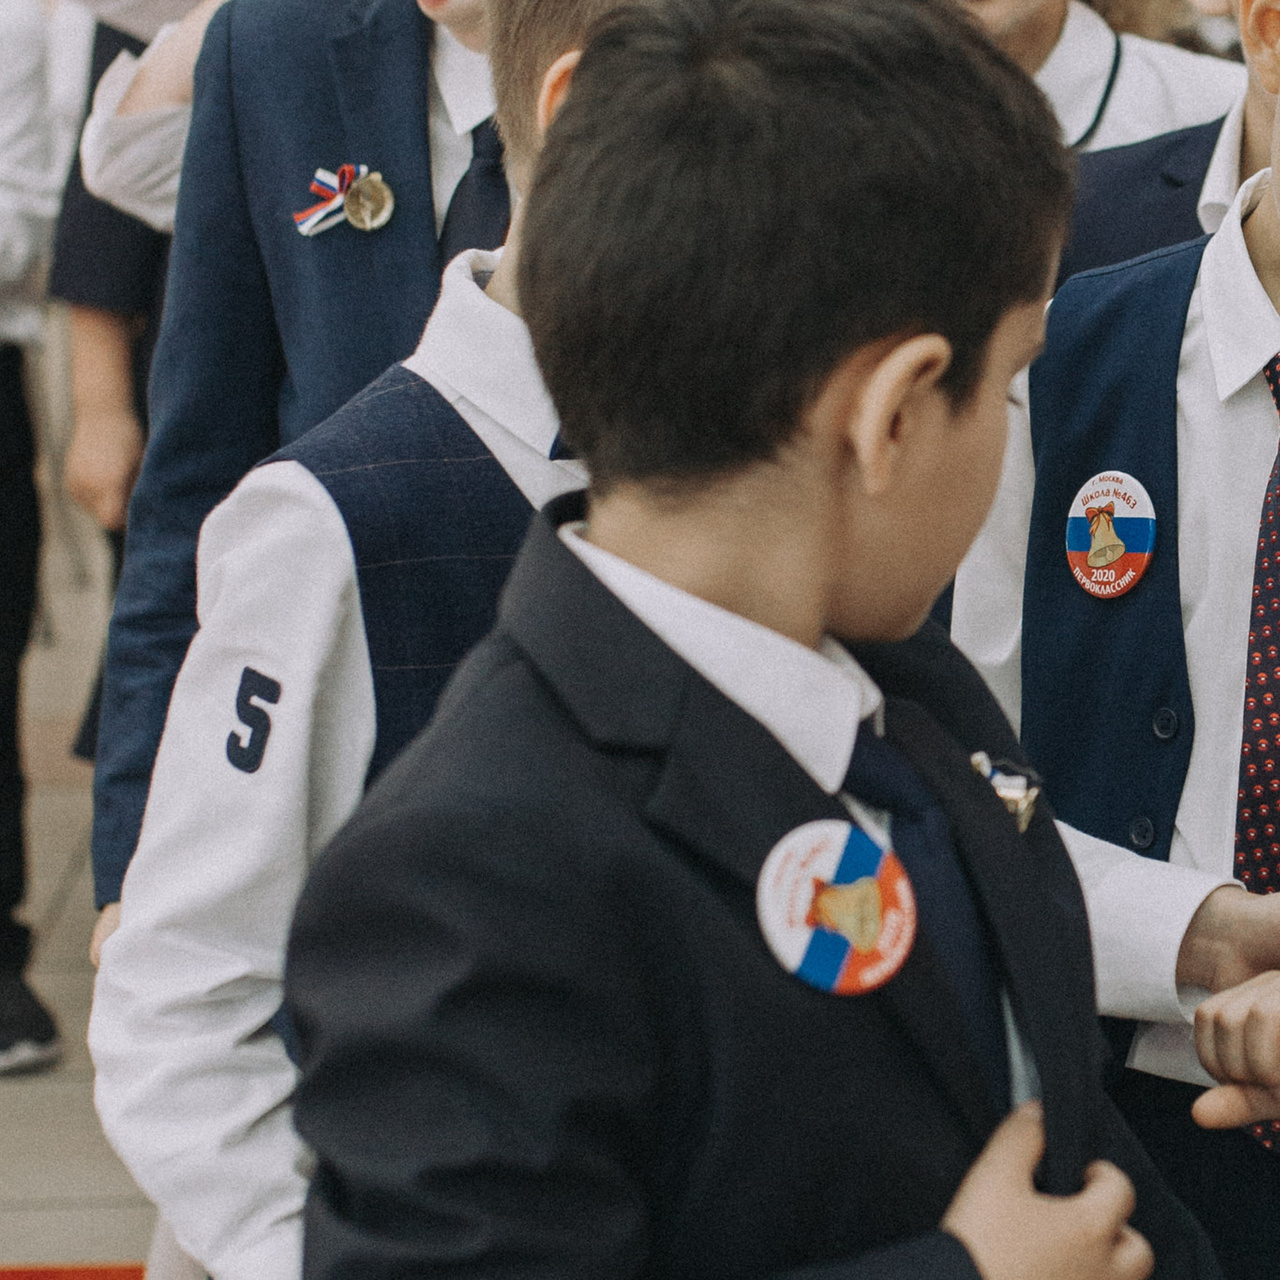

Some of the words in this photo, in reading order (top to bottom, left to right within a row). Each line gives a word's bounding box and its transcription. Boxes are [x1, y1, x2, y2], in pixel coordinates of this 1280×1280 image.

[1098, 475, 1124, 485] Москва
[1081, 488, 1111, 507] Школа
[1112, 487, 1138, 509] №463
[1073, 566, 1137, 595] ПЕРВОКЛАССНИК
[1090, 568, 1116, 582] 2020
